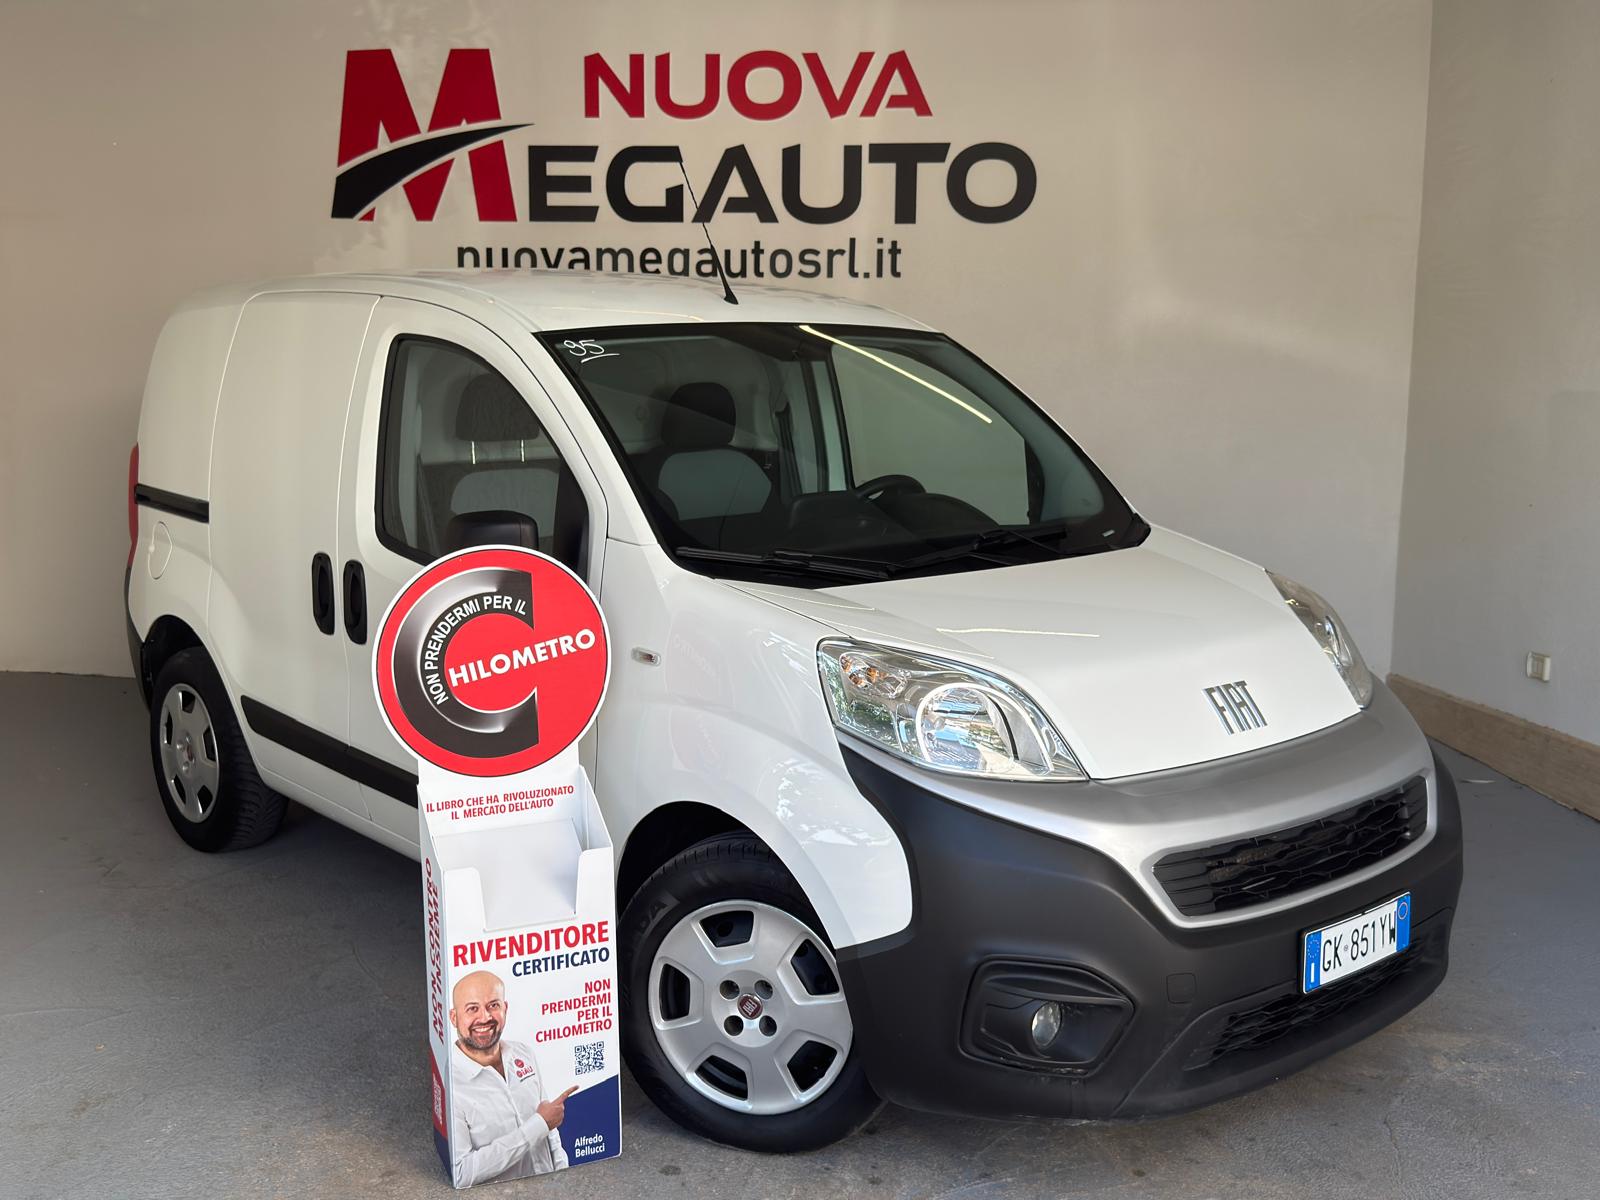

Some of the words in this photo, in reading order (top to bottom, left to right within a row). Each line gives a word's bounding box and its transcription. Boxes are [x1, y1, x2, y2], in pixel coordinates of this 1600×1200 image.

[584, 50, 933, 121] NUOVA
[483, 595, 513, 611] PER
[514, 599, 527, 616] IL
[425, 599, 481, 671] PRENDERMI
[425, 672, 449, 705] NON
[1202, 680, 1268, 735] FIAT
[426, 803, 435, 813] IL
[436, 799, 464, 812] LIBRO
[466, 796, 484, 808] CHE
[486, 794, 499, 804] HA
[503, 785, 574, 803] RIVOLUZIONATO
[451, 811, 460, 820] IL
[463, 803, 506, 819] MERCATO
[508, 798, 554, 813] DELL'AUTO
[453, 920, 609, 967] RIVENDITORE
[1322, 934, 1343, 972] GK
[1350, 911, 1397, 961] 851YW
[512, 947, 610, 977] CERTIFICATO
[584, 978, 611, 994] NON
[541, 992, 612, 1015] PRENDERMI
[577, 1009, 600, 1022] PER
[602, 1006, 613, 1018] IL
[535, 1018, 612, 1043] CHILOMETRO
[574, 1133, 604, 1148] Alfredo
[575, 1144, 605, 1158] Bellucci
